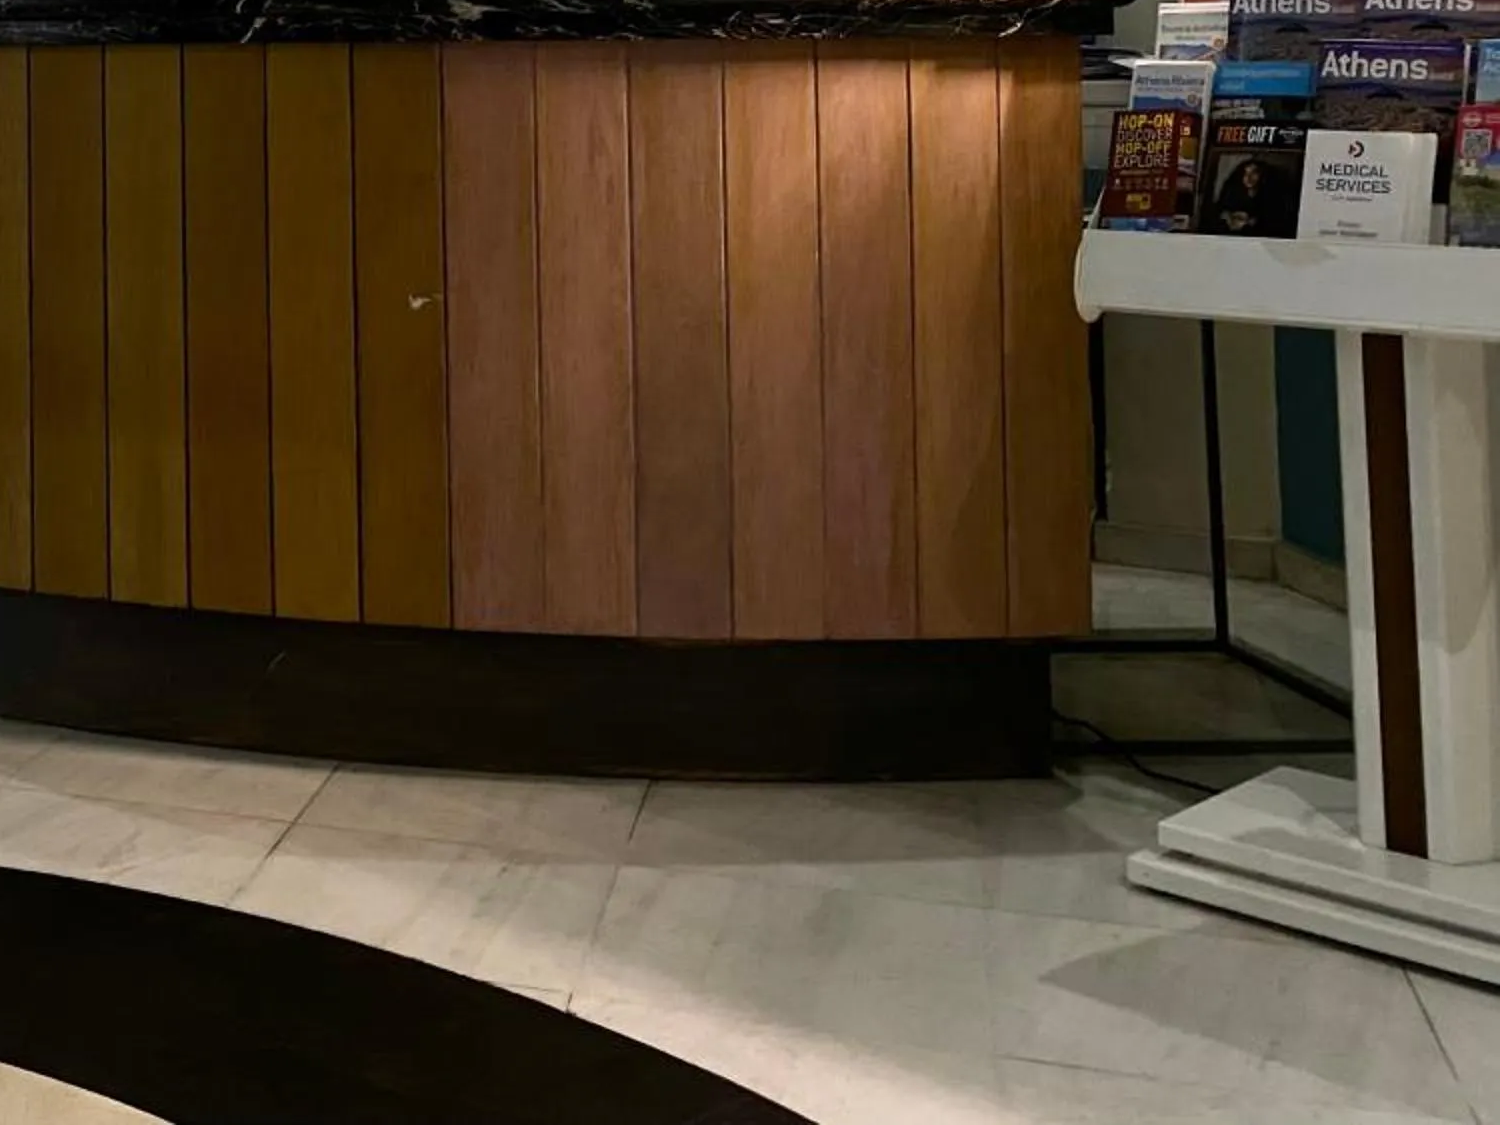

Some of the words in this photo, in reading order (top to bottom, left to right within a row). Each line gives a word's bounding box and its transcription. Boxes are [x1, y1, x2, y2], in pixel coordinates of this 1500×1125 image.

[1321, 50, 1429, 80] Athens
[1119, 112, 1175, 128] HOP-ON
[1117, 127, 1173, 142] DISCOVER
[1217, 126, 1246, 143] FREE
[1247, 125, 1278, 144] GIFT
[1116, 140, 1173, 155] HOP-OFF
[1114, 153, 1171, 168] EXPLORE
[1320, 162, 1389, 178] MEDICAL
[1315, 178, 1392, 194] SERVICES
